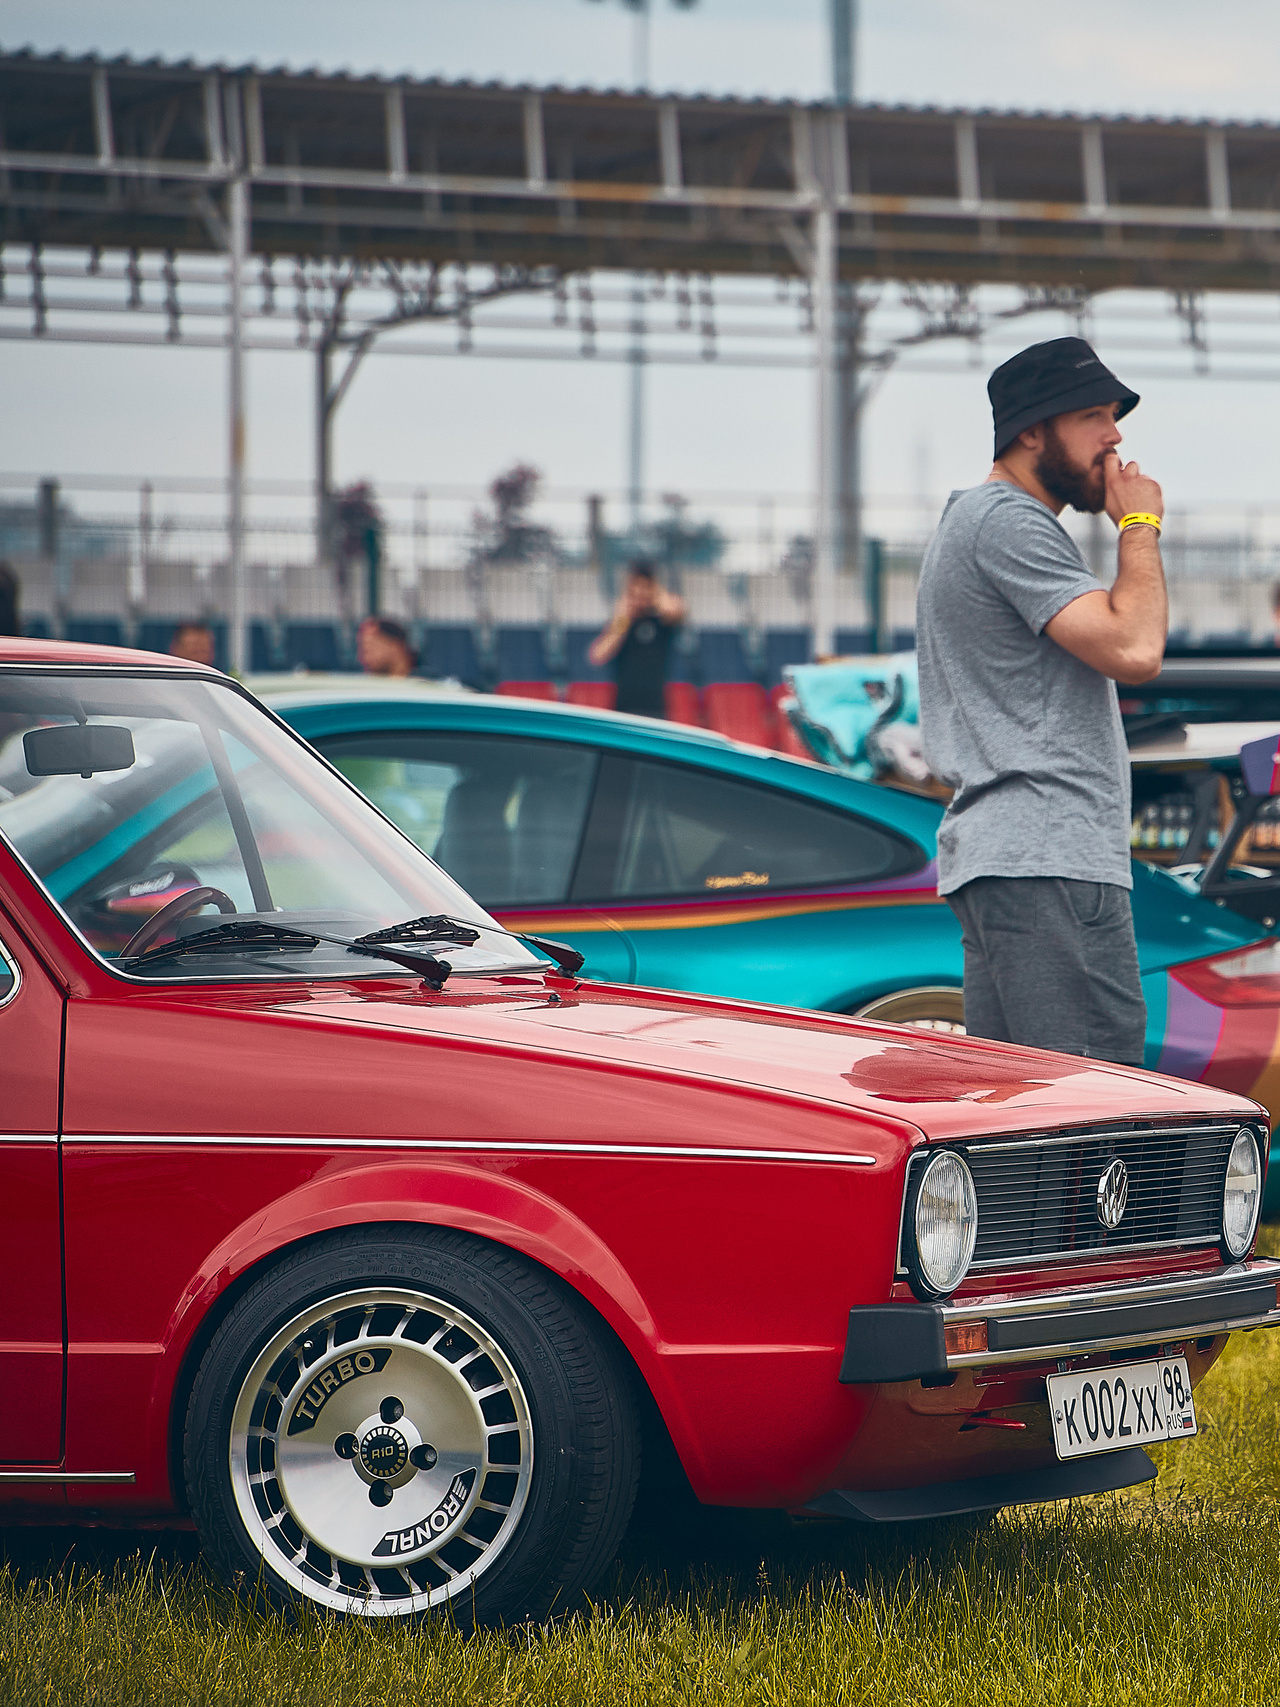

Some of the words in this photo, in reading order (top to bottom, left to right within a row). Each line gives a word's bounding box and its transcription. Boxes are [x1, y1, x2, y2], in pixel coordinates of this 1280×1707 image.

[294, 1350, 376, 1421] TURBO
[1163, 1365, 1185, 1411] 98
[1167, 1412, 1183, 1430] RUS
[384, 1493, 464, 1553] RONAL
